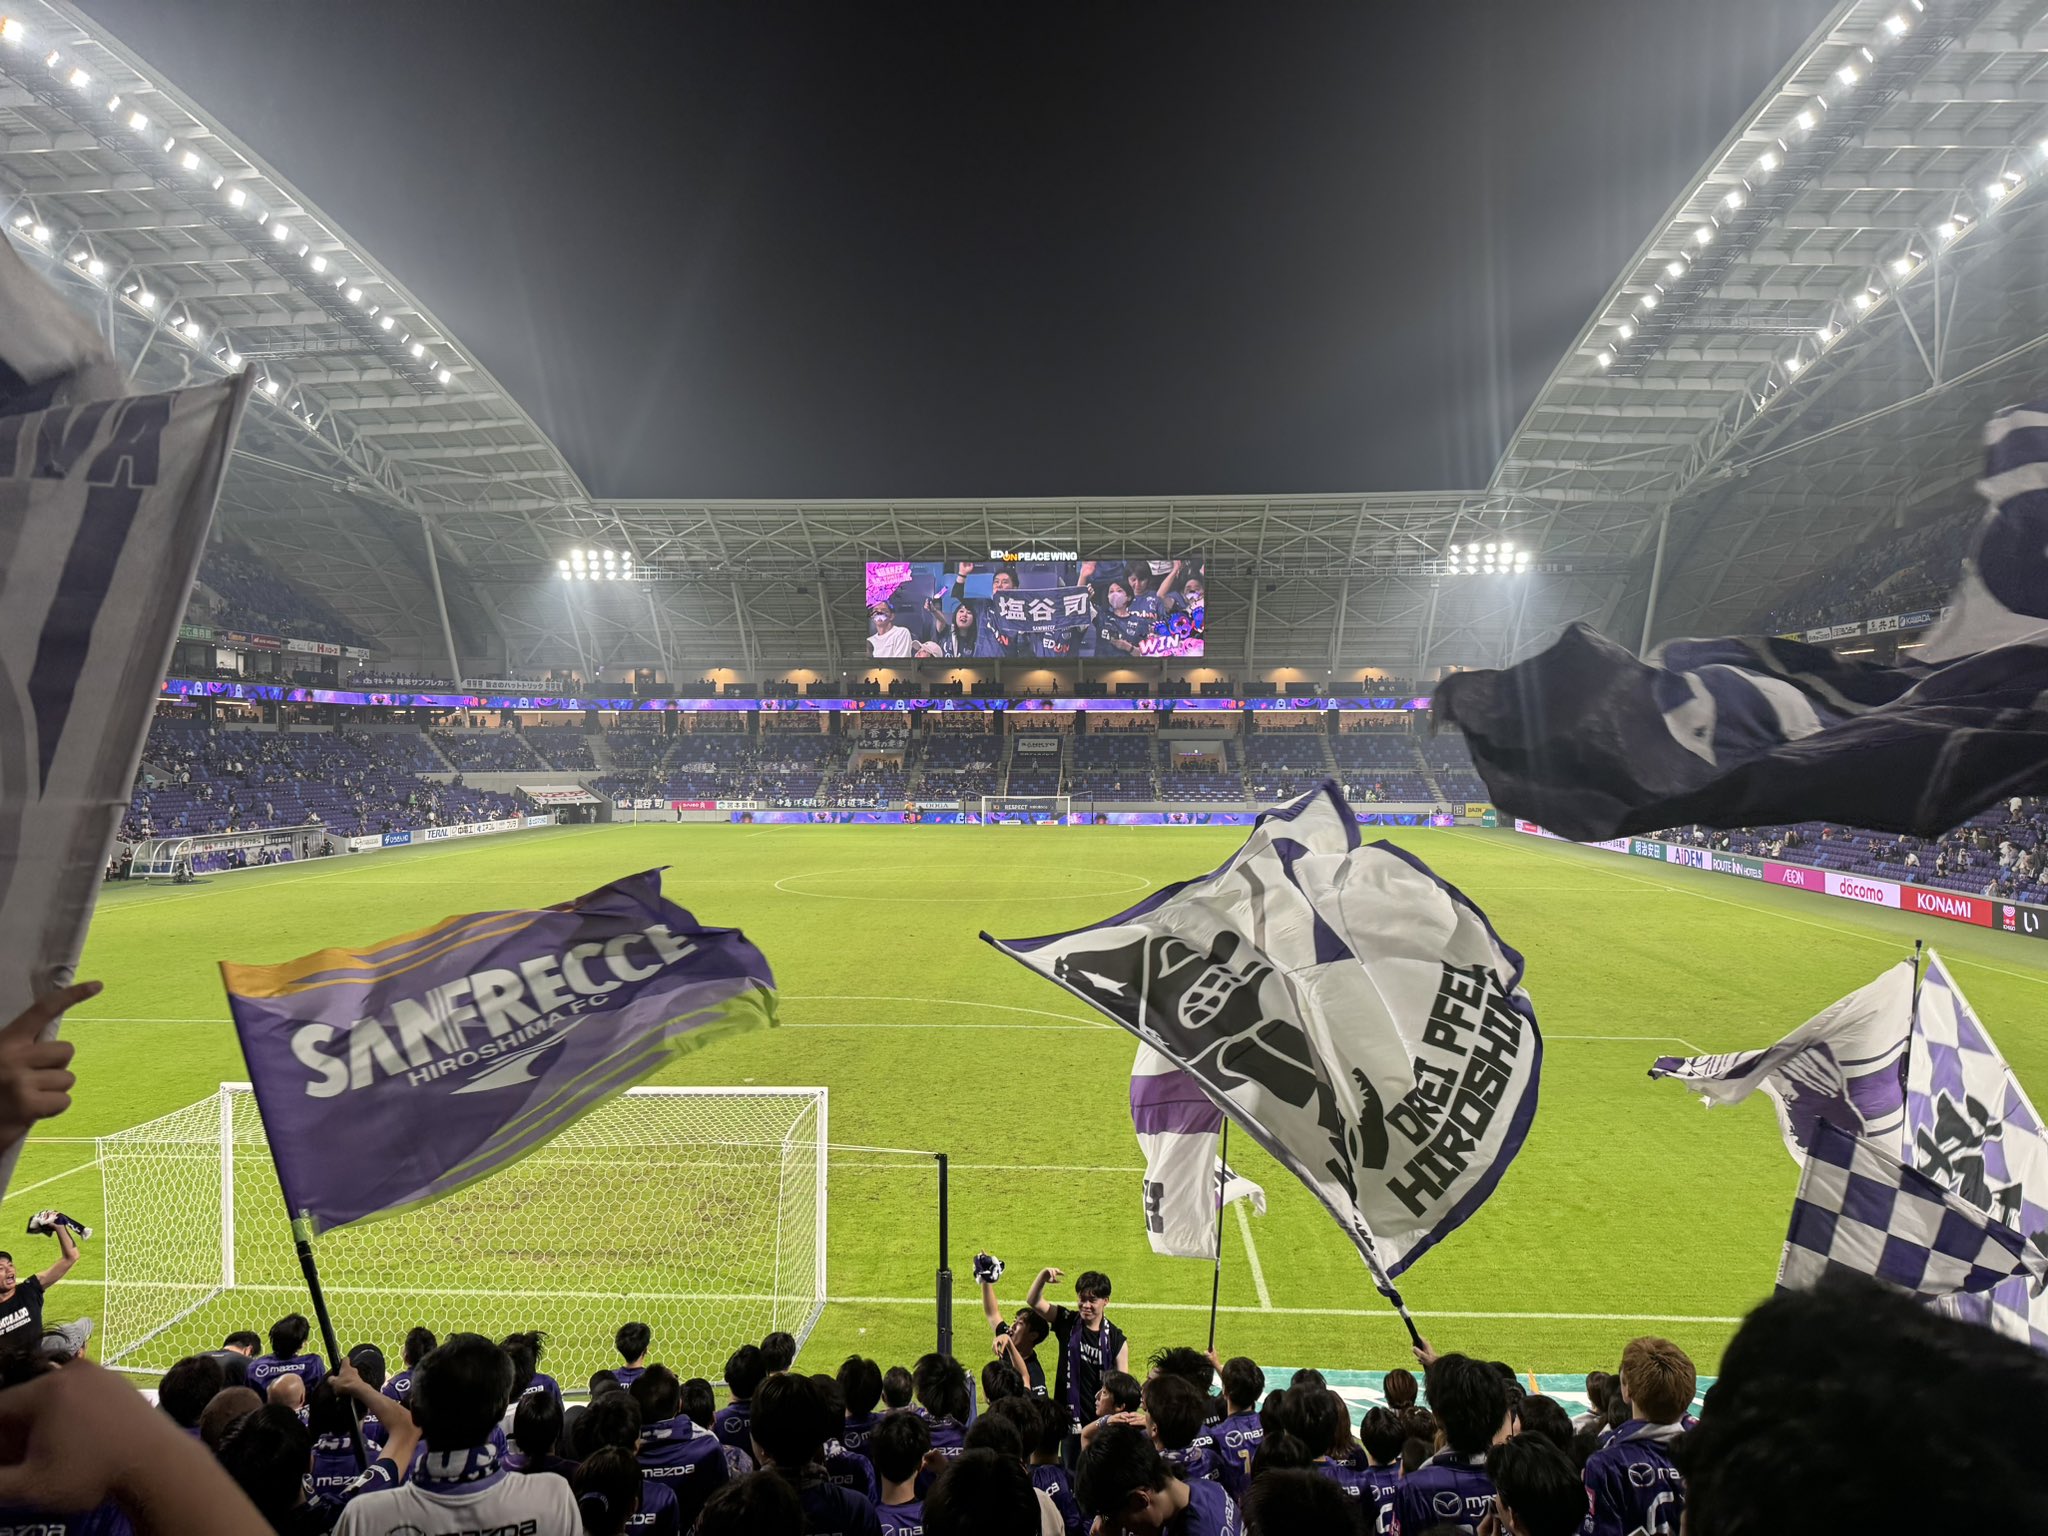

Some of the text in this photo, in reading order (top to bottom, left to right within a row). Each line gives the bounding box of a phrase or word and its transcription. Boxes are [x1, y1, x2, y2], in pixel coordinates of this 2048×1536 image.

[991, 551, 1078, 562] EDION PEACE WING
[999, 593, 1088, 622] 塩谷 司
[1878, 619, 1897, 631] 共立
[1139, 634, 1181, 655] WIN
[427, 829, 449, 838] TERAL
[1635, 841, 1660, 859] 明治安田
[1713, 858, 1732, 873] ROUTE
[1744, 867, 1762, 878] HOTELS
[1840, 877, 1883, 902] docomo
[1917, 892, 1971, 919] KONAMI
[290, 923, 698, 1098] SANFRECCE
[405, 992, 611, 1087] HIROSHIMA FC
[1384, 1056, 1459, 1147] DREI
[270, 1363, 306, 1373] mazda
[523, 1385, 544, 1395] zda
[1192, 1436, 1213, 1447] zda
[1243, 1428, 1264, 1440] maz
[641, 1463, 695, 1478] mazda
[316, 1475, 355, 1487] maz
[625, 1512, 656, 1525] zda
